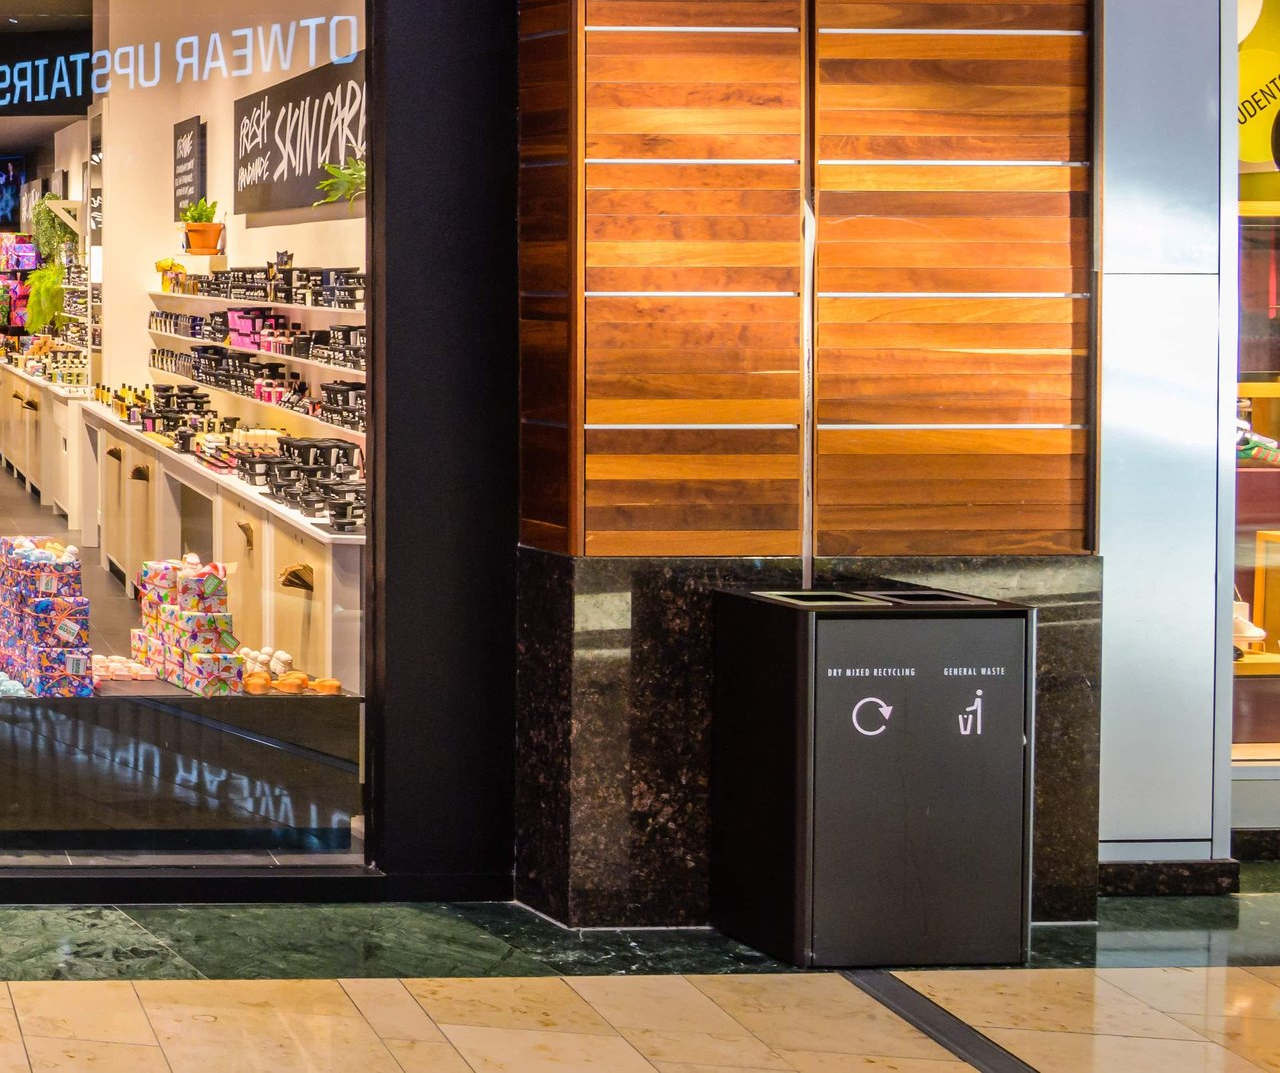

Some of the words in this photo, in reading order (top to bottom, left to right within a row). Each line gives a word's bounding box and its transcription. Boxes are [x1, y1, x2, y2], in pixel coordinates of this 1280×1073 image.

[239, 95, 271, 159] FRESH
[238, 151, 271, 192] HANDMADE
[827, 668, 842, 676] DRY
[846, 668, 870, 676] MIXED
[873, 668, 915, 677] RECYCLING
[944, 667, 977, 676] GENERAL
[980, 667, 1005, 675] WASTE
